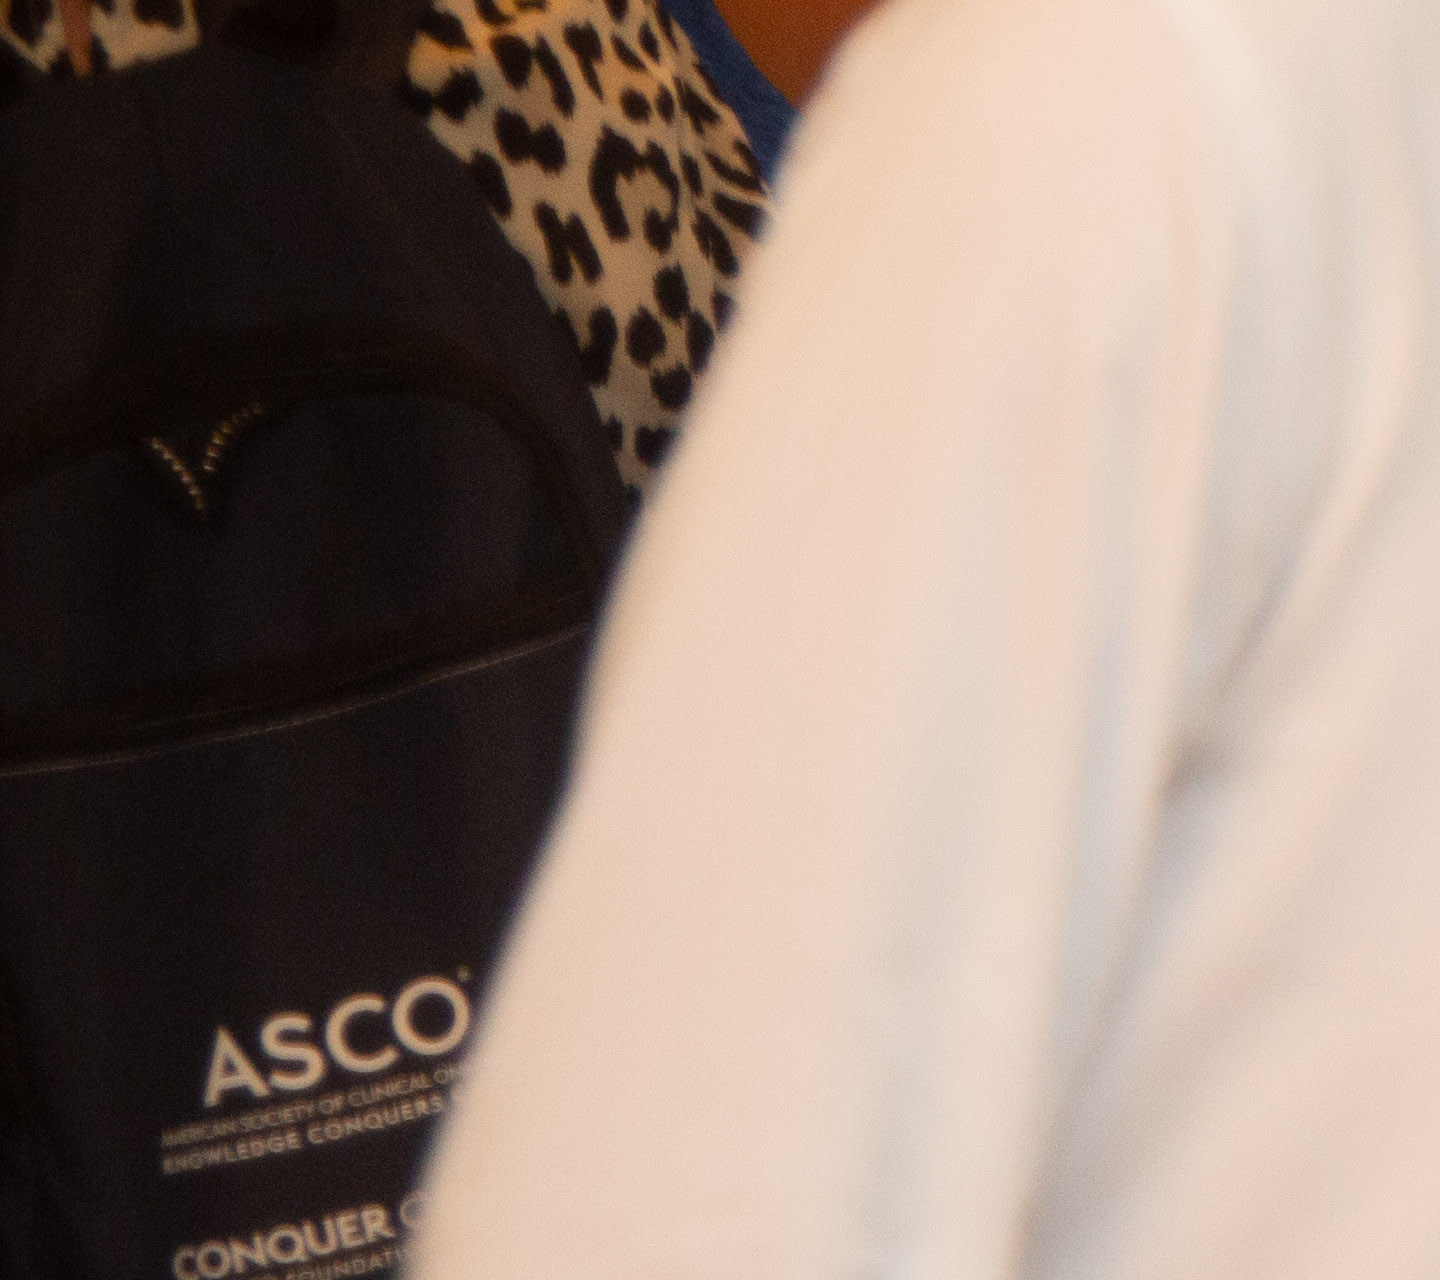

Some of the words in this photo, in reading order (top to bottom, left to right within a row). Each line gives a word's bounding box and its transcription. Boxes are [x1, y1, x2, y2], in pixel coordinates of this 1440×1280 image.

[205, 977, 470, 1106] ASCO
[162, 1132, 303, 1176] KNOWLEDGE
[306, 1095, 444, 1145] CONQUERS
[240, 1106, 318, 1132] SOCIETY
[318, 1093, 347, 1114] OF
[349, 1074, 433, 1107] CLINICAL
